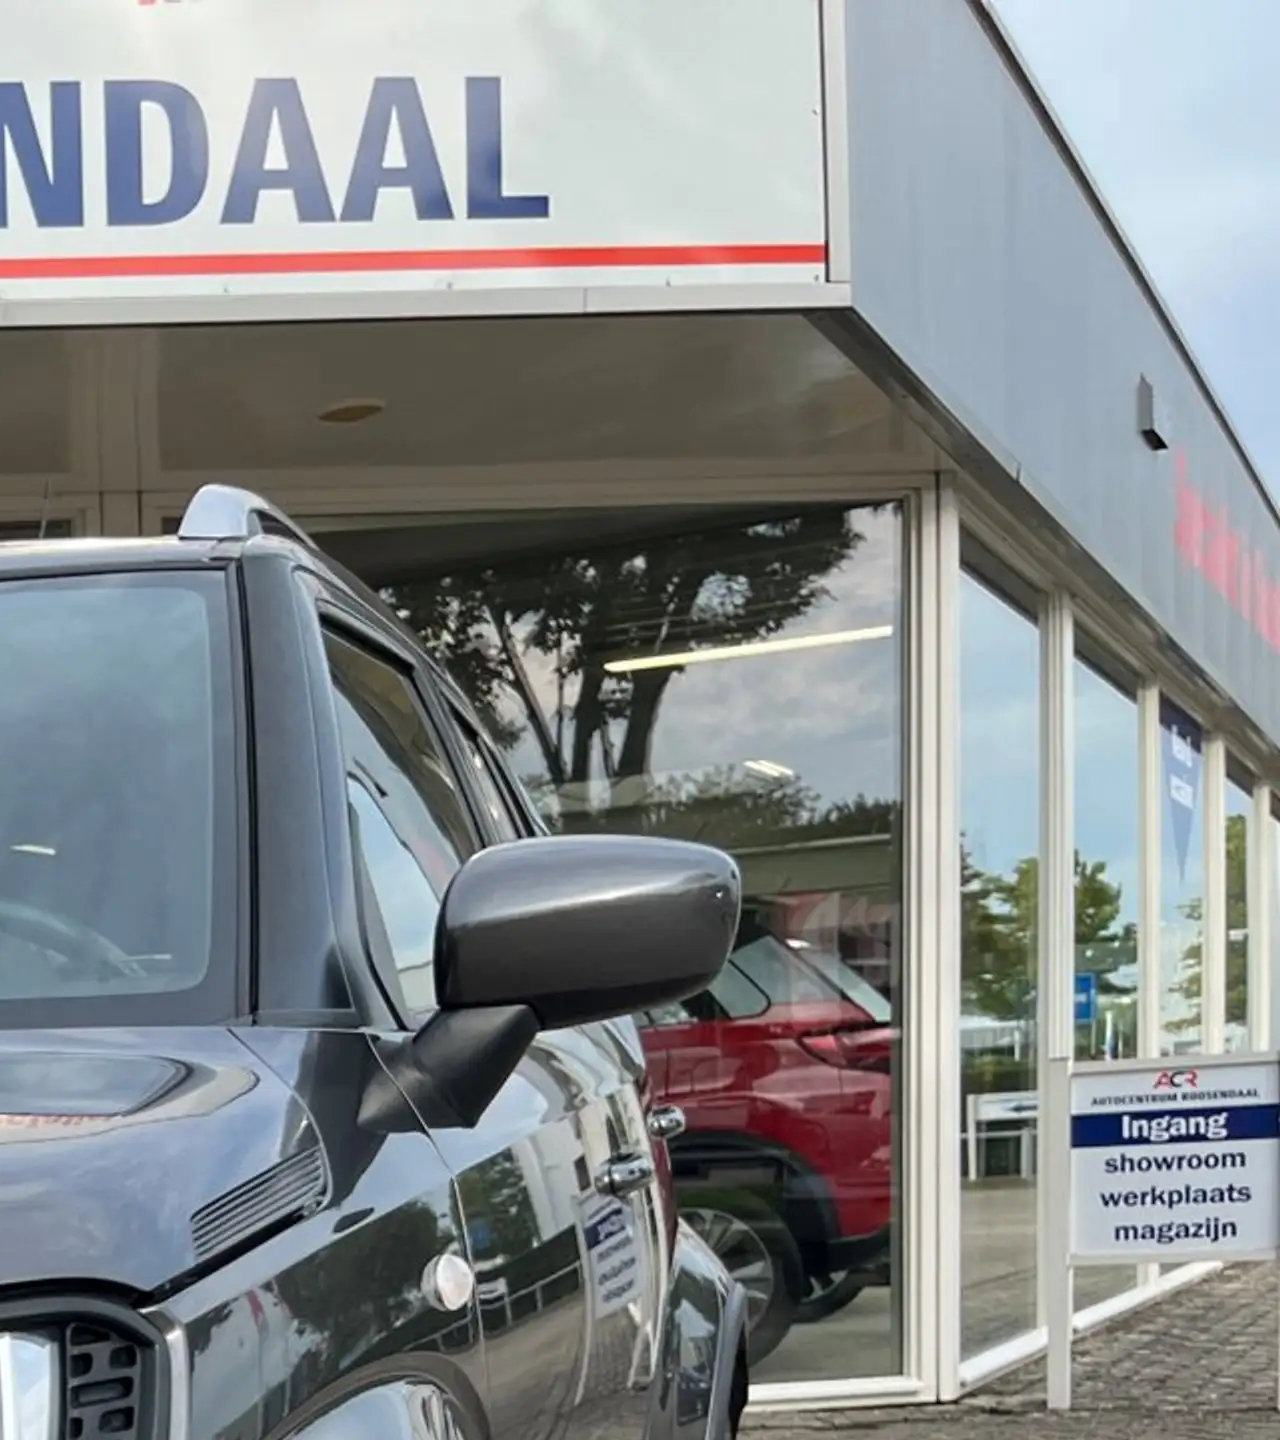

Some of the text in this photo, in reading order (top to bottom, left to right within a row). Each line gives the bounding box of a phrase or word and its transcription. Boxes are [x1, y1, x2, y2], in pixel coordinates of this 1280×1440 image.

[1153, 1067, 1199, 1089] ACR
[1091, 1087, 1261, 1107] AUTOCENTRUM ROOSENDAAL
[1122, 1112, 1229, 1142] Ingang
[1104, 1151, 1247, 1174] showroom
[1099, 1183, 1252, 1209] werkplaats
[1114, 1217, 1238, 1244] magazijn
